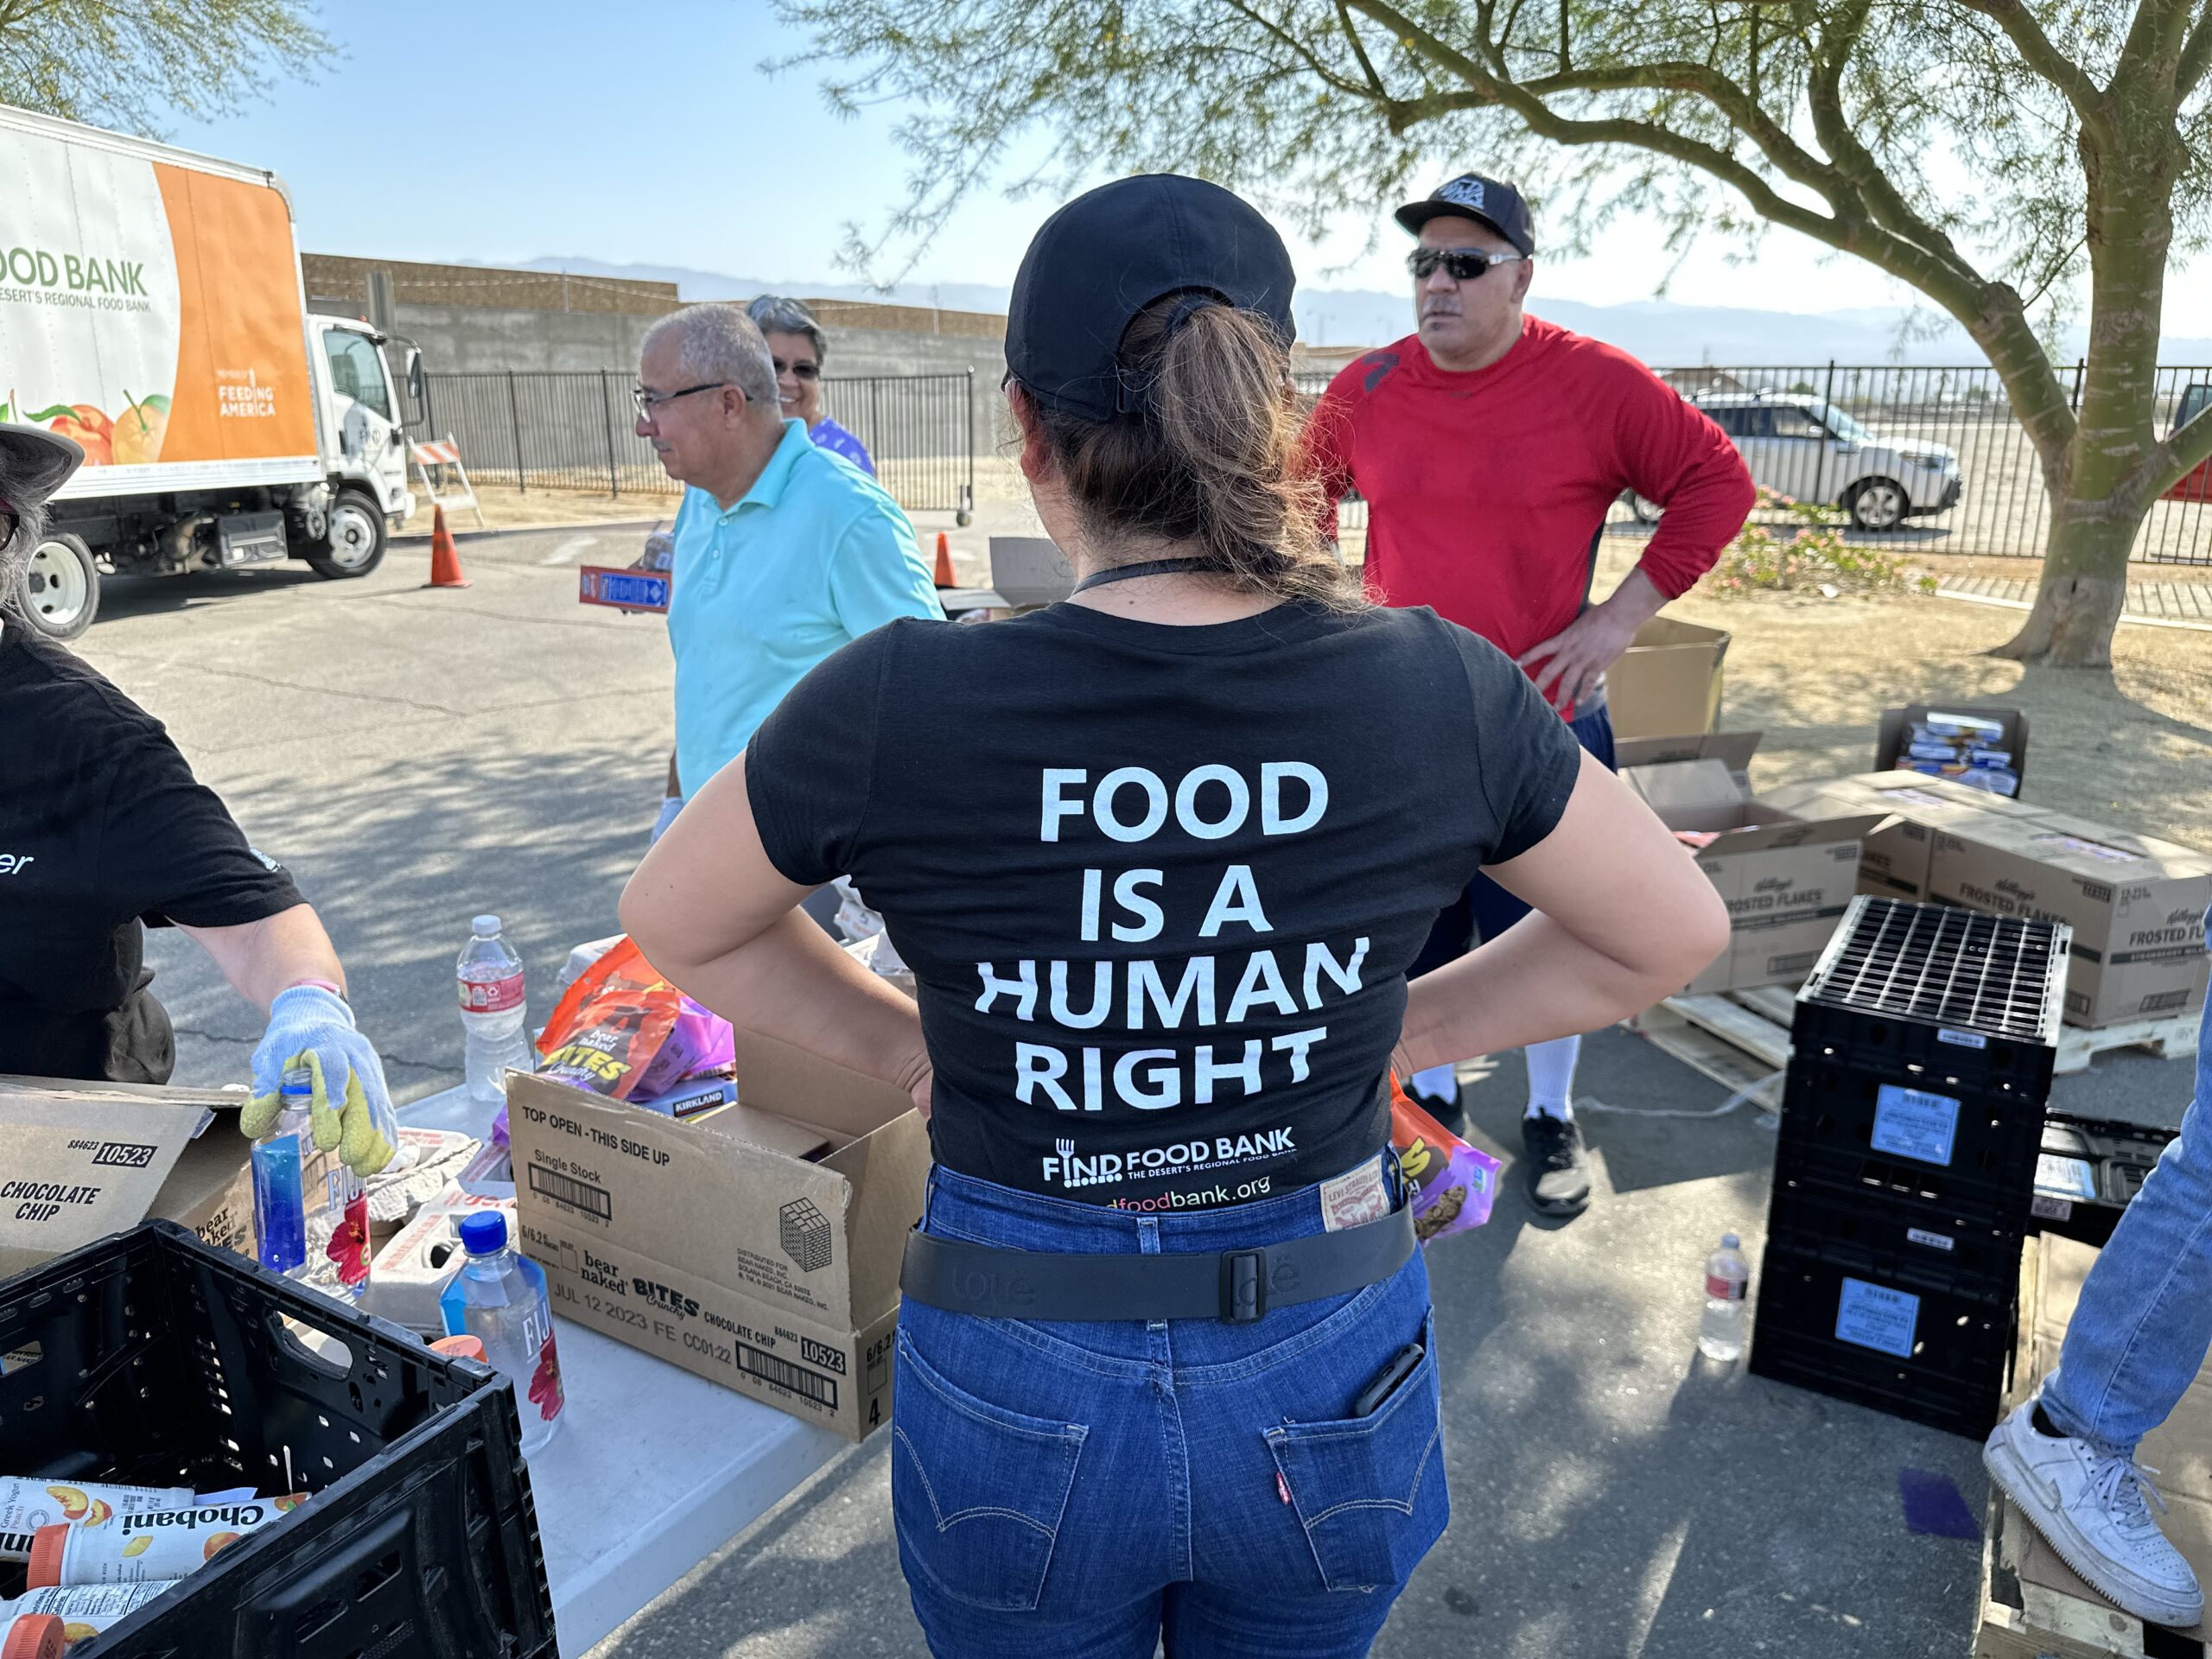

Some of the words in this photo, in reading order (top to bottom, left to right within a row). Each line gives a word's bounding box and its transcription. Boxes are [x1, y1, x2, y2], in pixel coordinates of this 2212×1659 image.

[0, 246, 59, 287] OD
[64, 253, 149, 296] BANK
[45, 292, 95, 309] REGIONAL
[98, 296, 124, 311] FOOD
[126, 299, 152, 313] BANK
[219, 385, 274, 401] FEEDING
[220, 402, 276, 417] AMERICA
[1039, 760, 1329, 842] FOOD
[1080, 868, 1164, 942] IS
[1198, 864, 1274, 937] A
[2129, 926, 2186, 947] FROSTED
[974, 937, 1370, 1029] HUMAN
[578, 1036, 616, 1052] naked
[590, 1030, 619, 1045] bear
[1014, 1027, 1327, 1111] RIGHT
[675, 1091, 722, 1112] KIRKLAND
[67, 1140, 99, 1150] 884623
[523, 1106, 546, 1122] TOP
[550, 1115, 582, 1137] OPEN
[590, 1128, 618, 1149] THIS
[621, 1139, 650, 1160] SIDE
[653, 1148, 670, 1166] UP
[96, 1145, 152, 1166] 10523
[1042, 1137, 1122, 1181] FIND
[1126, 1141, 1210, 1171] FOOD
[1215, 1126, 1295, 1160] BANK
[534, 1149, 568, 1171] Single
[570, 1163, 601, 1185] Stock
[1127, 1171, 1146, 1180] THE
[1148, 1164, 1192, 1178] DESERT'S
[1193, 1158, 1240, 1171] REGIONAL
[1243, 1154, 1270, 1162] FOOD
[0, 1181, 101, 1205] CHOCOLATE
[1328, 1188, 1344, 1202] LEVI
[15, 1202, 60, 1222] CHIP
[195, 1208, 229, 1238] bear
[522, 1224, 543, 1244] 6/6.2
[583, 1250, 618, 1277] bear
[737, 1248, 775, 1267] DISTRIBUTED
[775, 1262, 788, 1271] FOR
[581, 1268, 626, 1295] naked
[785, 1281, 793, 1289] CA
[632, 1277, 700, 1317] BITES
[647, 1294, 686, 1320] Crunchy
[554, 1283, 581, 1306] JUL
[585, 1294, 601, 1313] 12
[606, 1302, 648, 1330] 2023
[653, 1319, 677, 1342] FE
[704, 1311, 752, 1340] CHOCOLATE
[755, 1331, 776, 1349] CHIP
[802, 1339, 844, 1372] 10523
[741, 1371, 746, 1380] 0
[799, 1396, 822, 1412] 10523
[830, 1408, 835, 1417] 2
[869, 1396, 880, 1426] 4
[1, 1504, 14, 1529] Greek
[10, 1506, 24, 1529] Peach
[122, 1505, 264, 1535] Chobani
